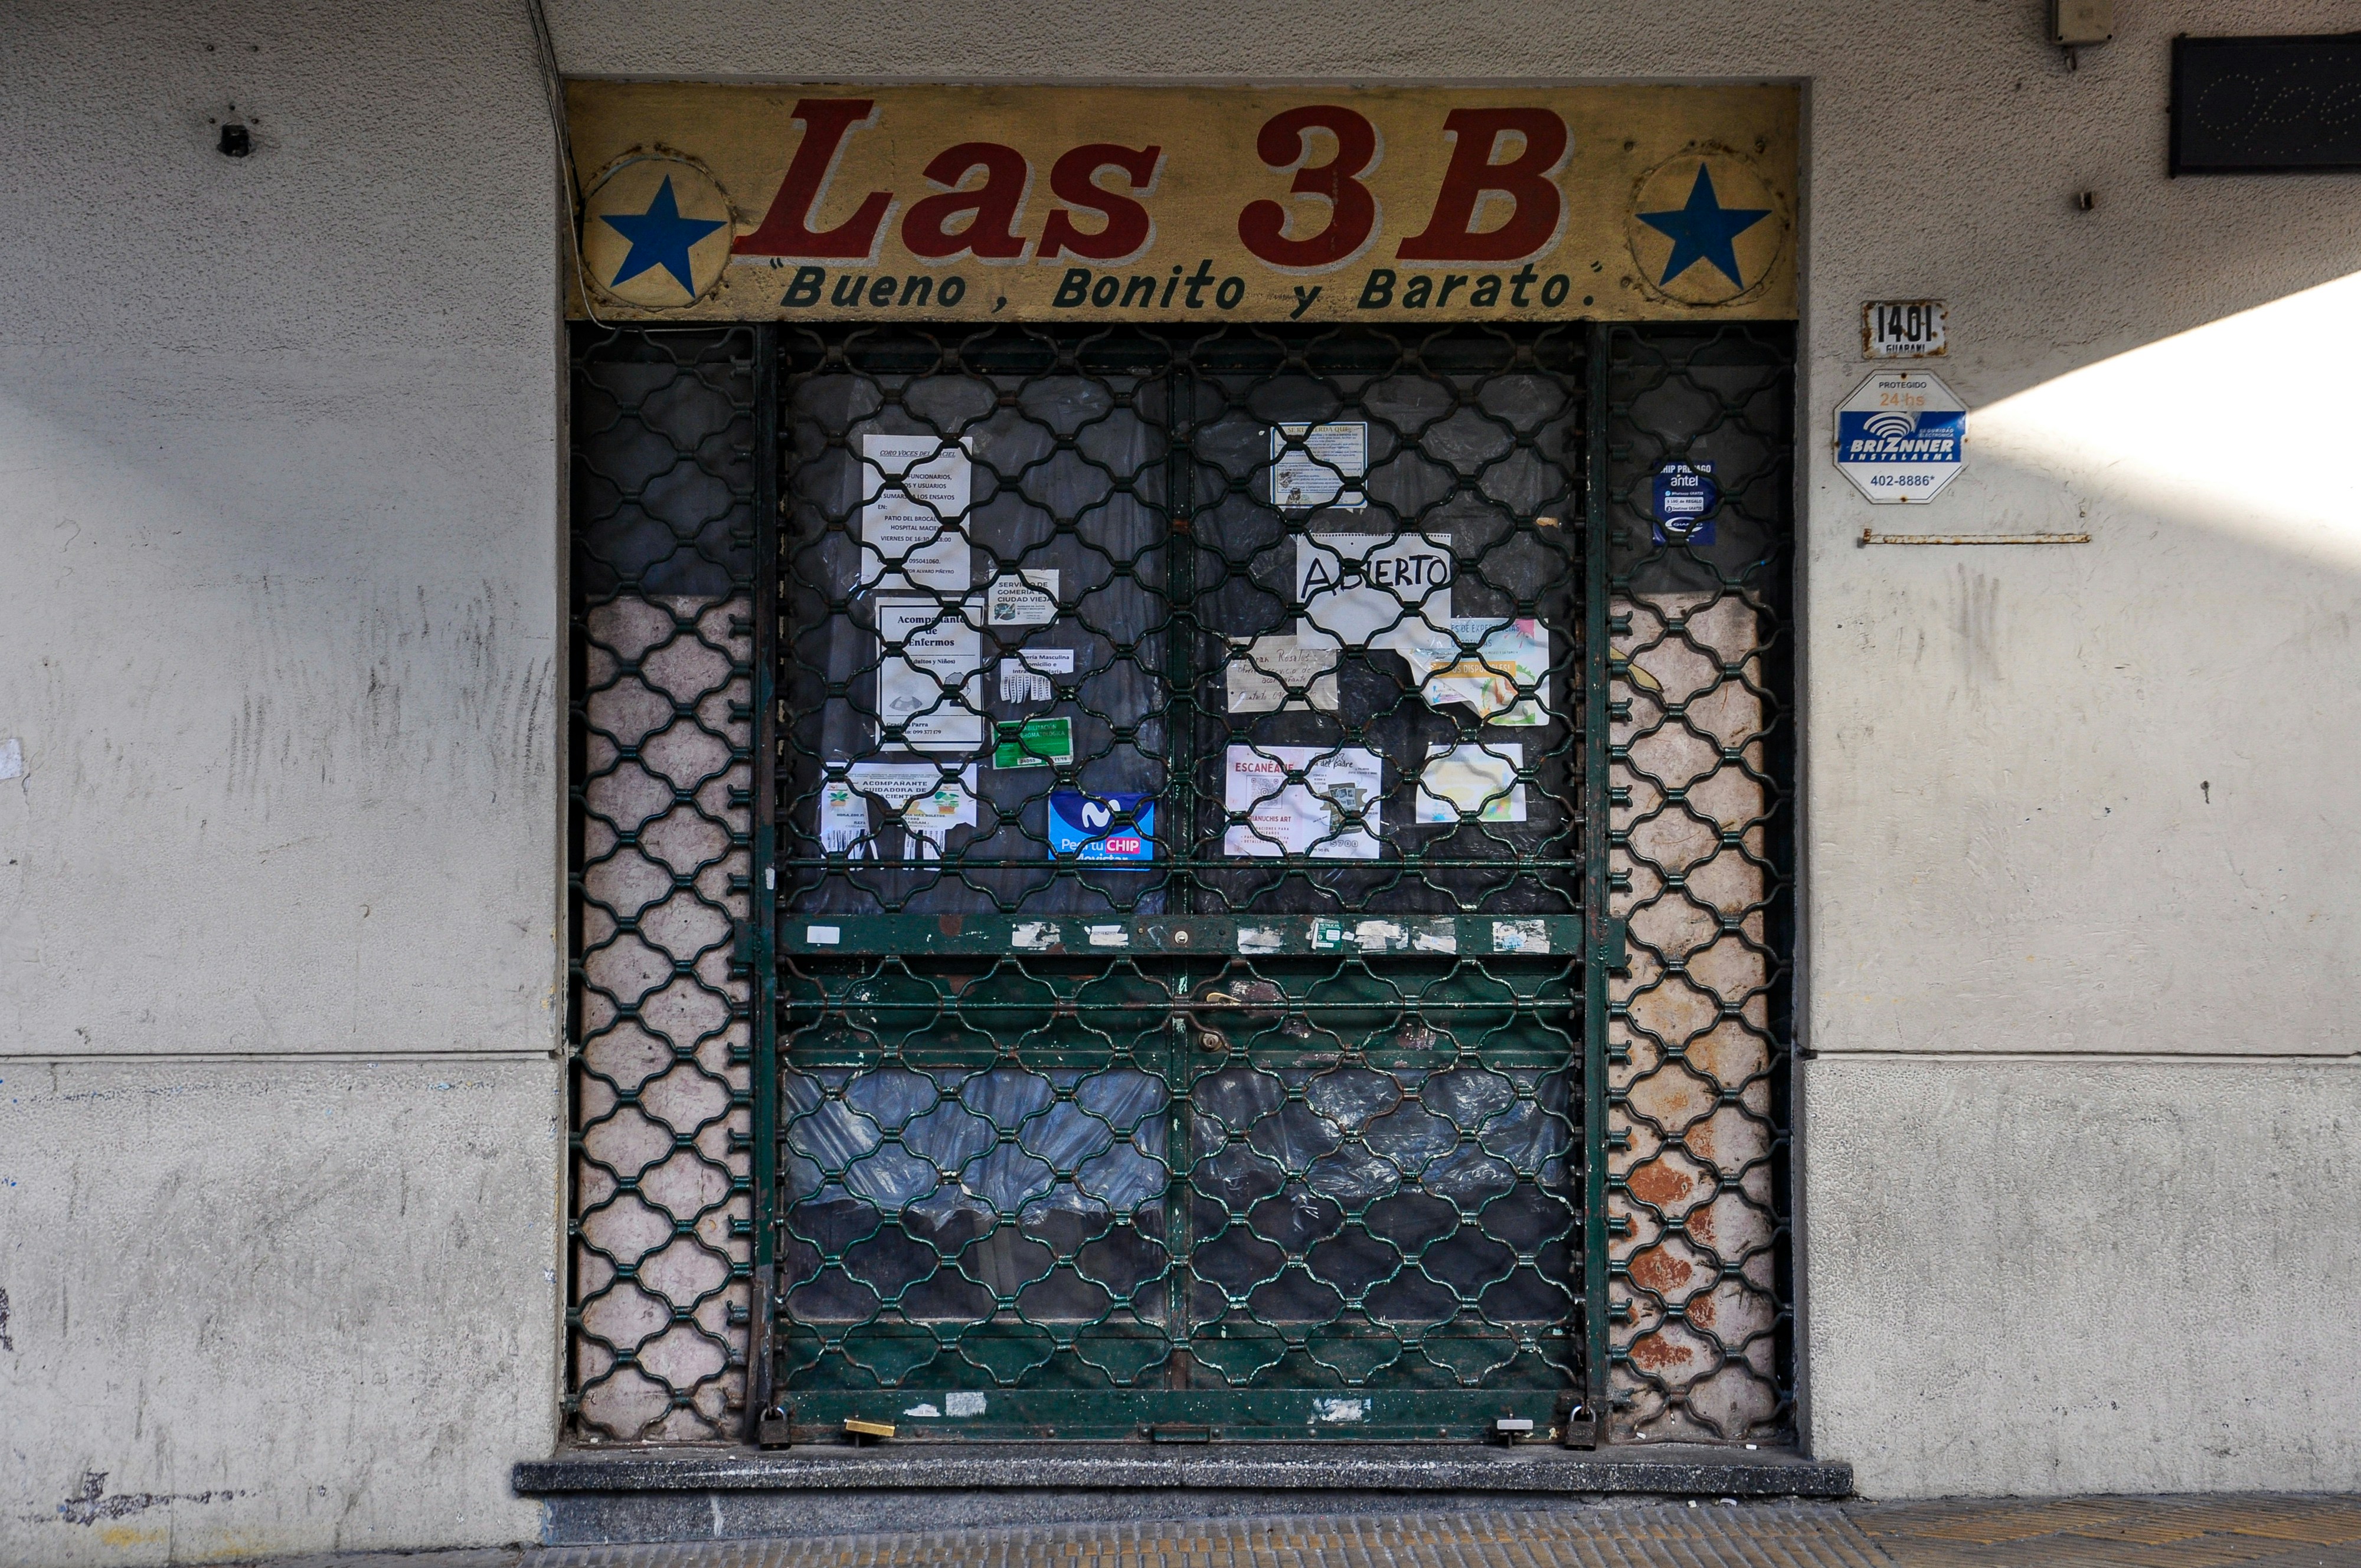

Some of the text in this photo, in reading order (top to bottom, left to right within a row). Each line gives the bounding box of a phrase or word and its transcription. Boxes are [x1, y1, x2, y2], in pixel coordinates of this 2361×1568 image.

[730, 99, 1572, 273] Las 3 B
[1052, 259, 1245, 309] Bonito
[1289, 284, 1322, 320] y
[1878, 305, 1933, 343] 1401
[1880, 392, 1925, 406] 24 hs
[1661, 465, 1676, 473] HIP
[1670, 474, 1699, 486] antel
[1461, 624, 1469, 633] DE
[908, 638, 955, 647] Enfermos
[1333, 760, 1353, 770] padre
[1091, 841, 1104, 851] tu
[1106, 839, 1140, 852] CHIP
